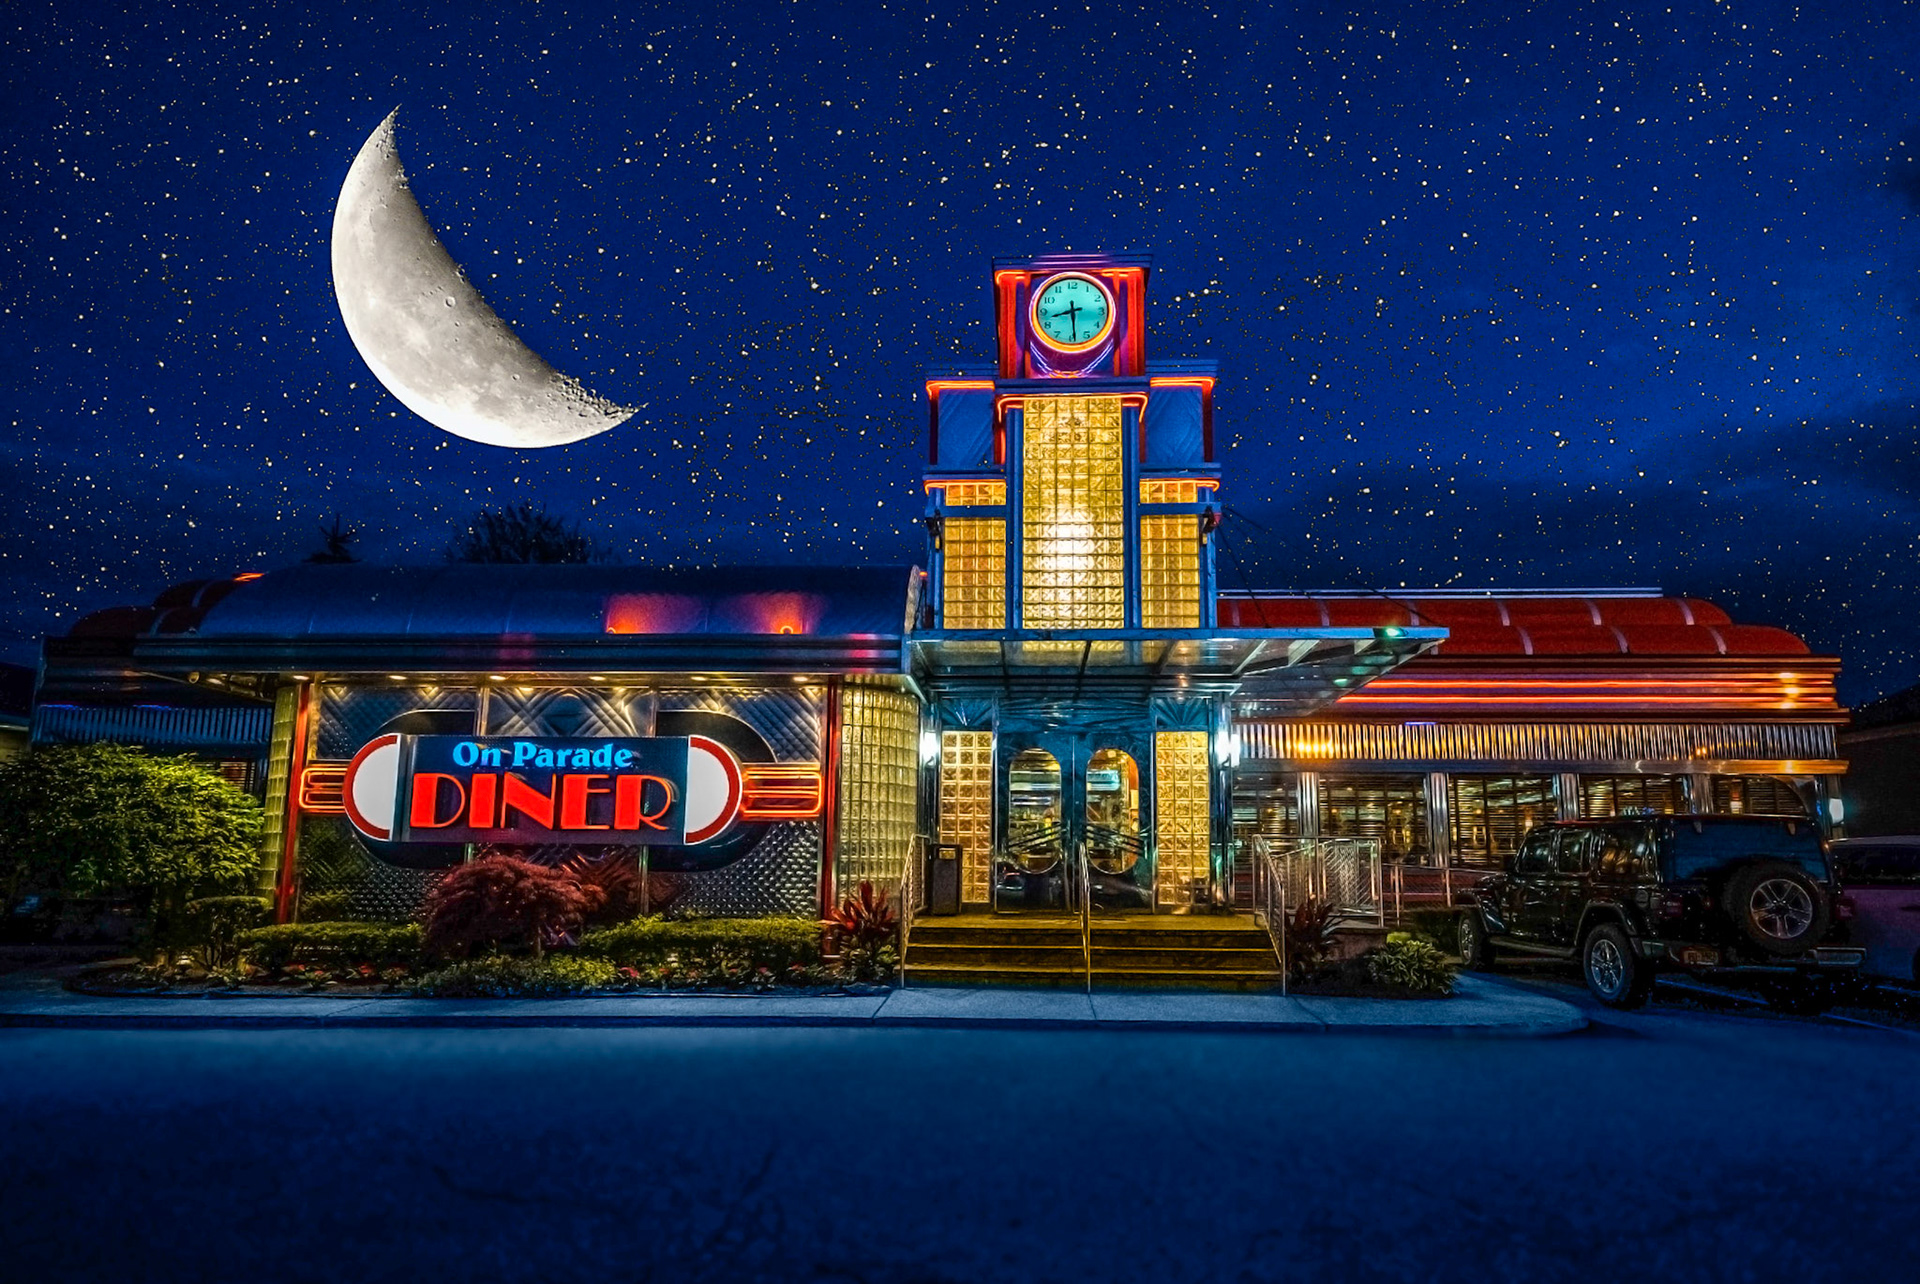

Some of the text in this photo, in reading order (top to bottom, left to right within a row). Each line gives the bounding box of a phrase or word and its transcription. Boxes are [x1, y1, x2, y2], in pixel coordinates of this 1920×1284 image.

[453, 741, 633, 768] On Parade
[409, 773, 670, 831] DINER
